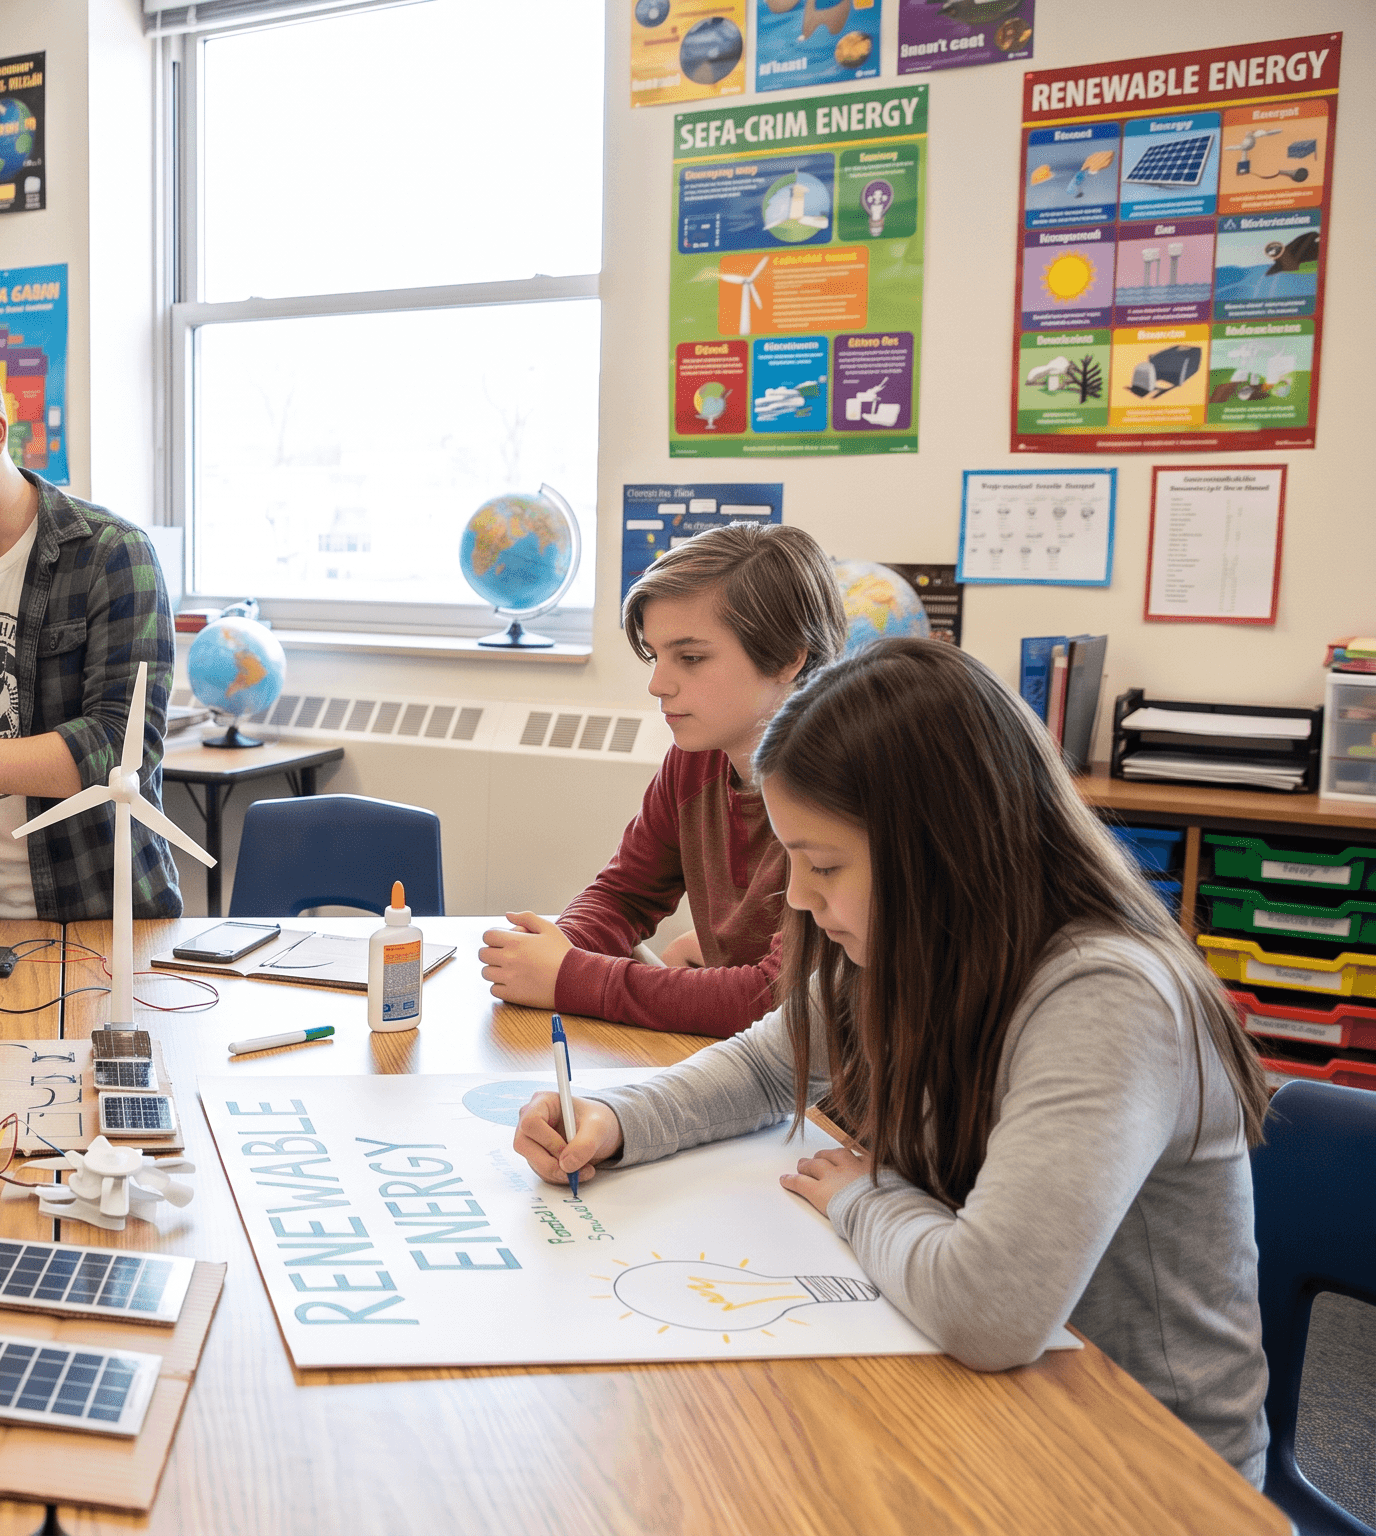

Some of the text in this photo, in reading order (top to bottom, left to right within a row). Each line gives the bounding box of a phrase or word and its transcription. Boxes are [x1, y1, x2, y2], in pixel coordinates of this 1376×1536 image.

[680, 97, 919, 150] SEFA-CRIM ENERGY
[1031, 48, 1330, 112] RENEWABLE ENERGY
[226, 1100, 419, 1325] RENEWABLE
[355, 1137, 523, 1271] ENERGY
